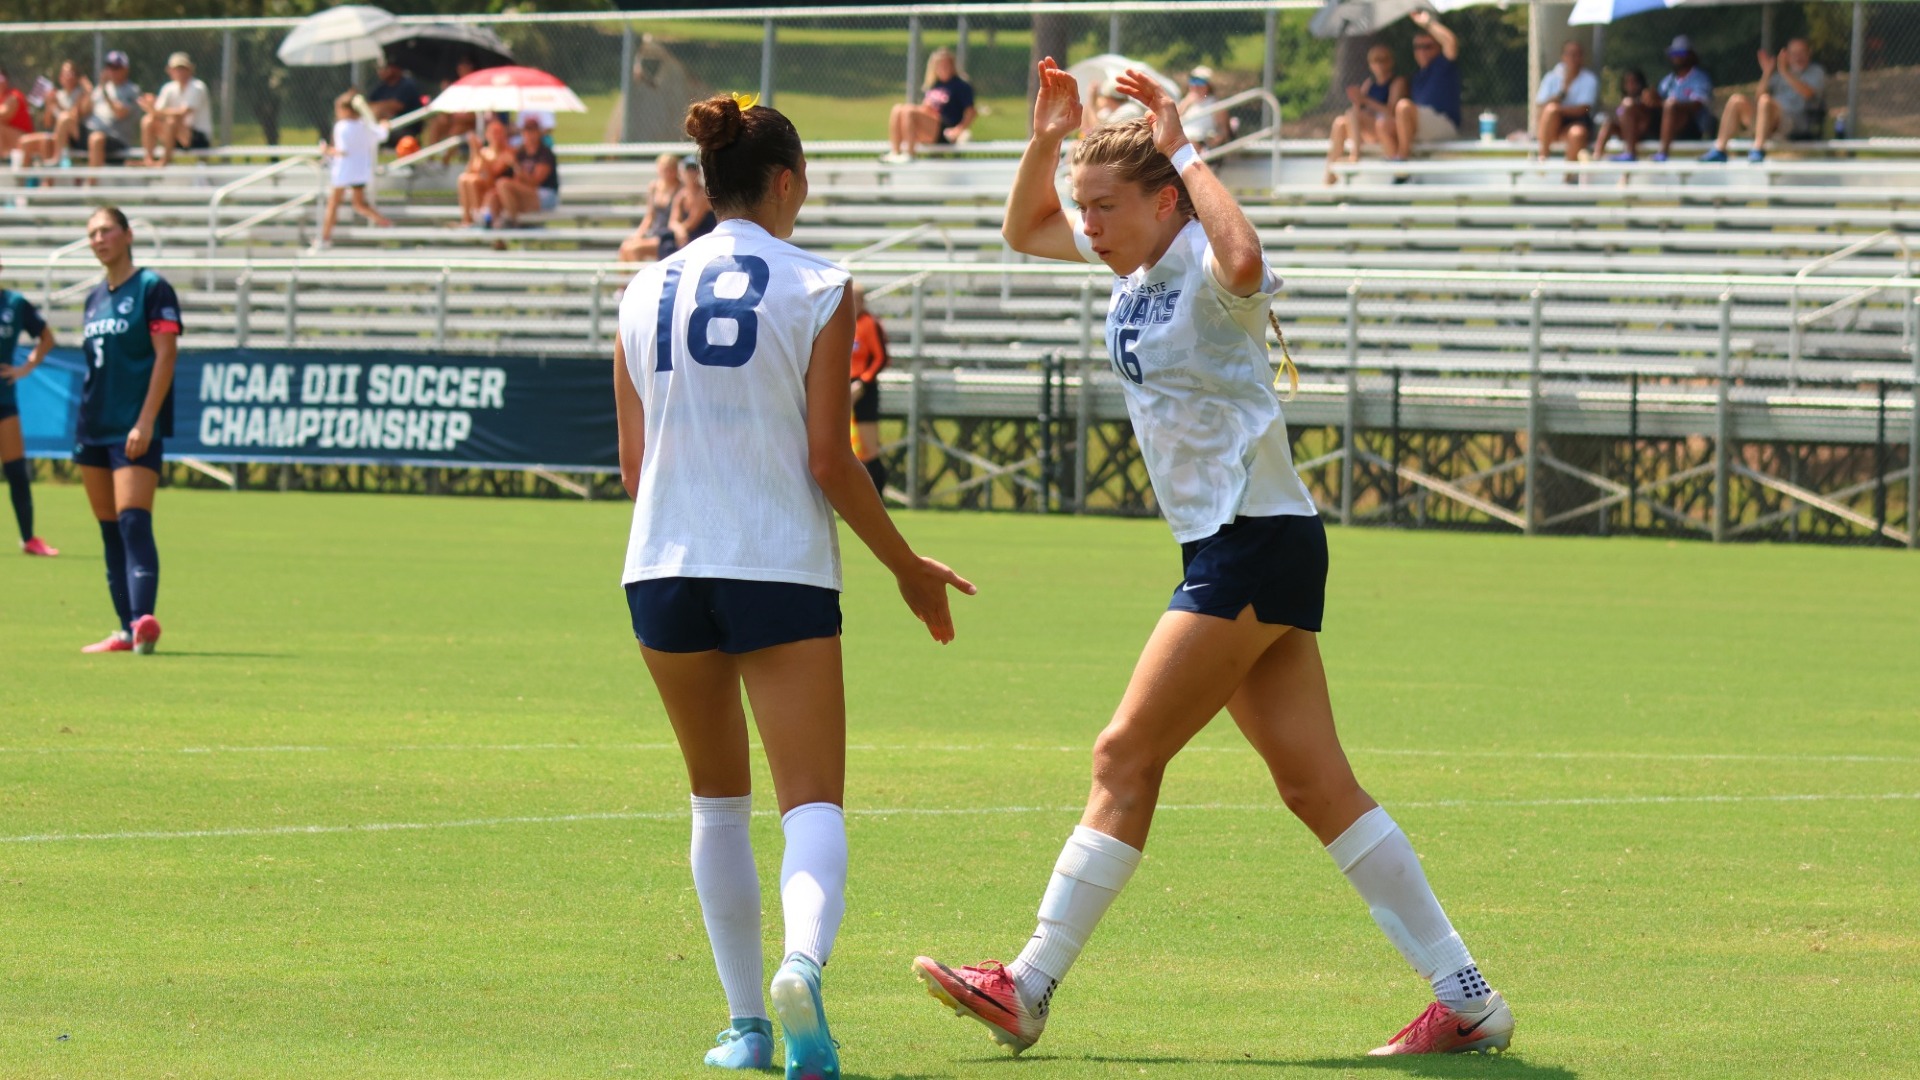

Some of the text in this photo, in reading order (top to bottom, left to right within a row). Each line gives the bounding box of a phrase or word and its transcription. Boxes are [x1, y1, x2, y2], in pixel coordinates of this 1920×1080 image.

[655, 254, 770, 372] 18
[1114, 328, 1144, 385] 16
[200, 362, 506, 409] NCAA DII SOCCER
[200, 405, 472, 451] CHAMPIONSHIP
